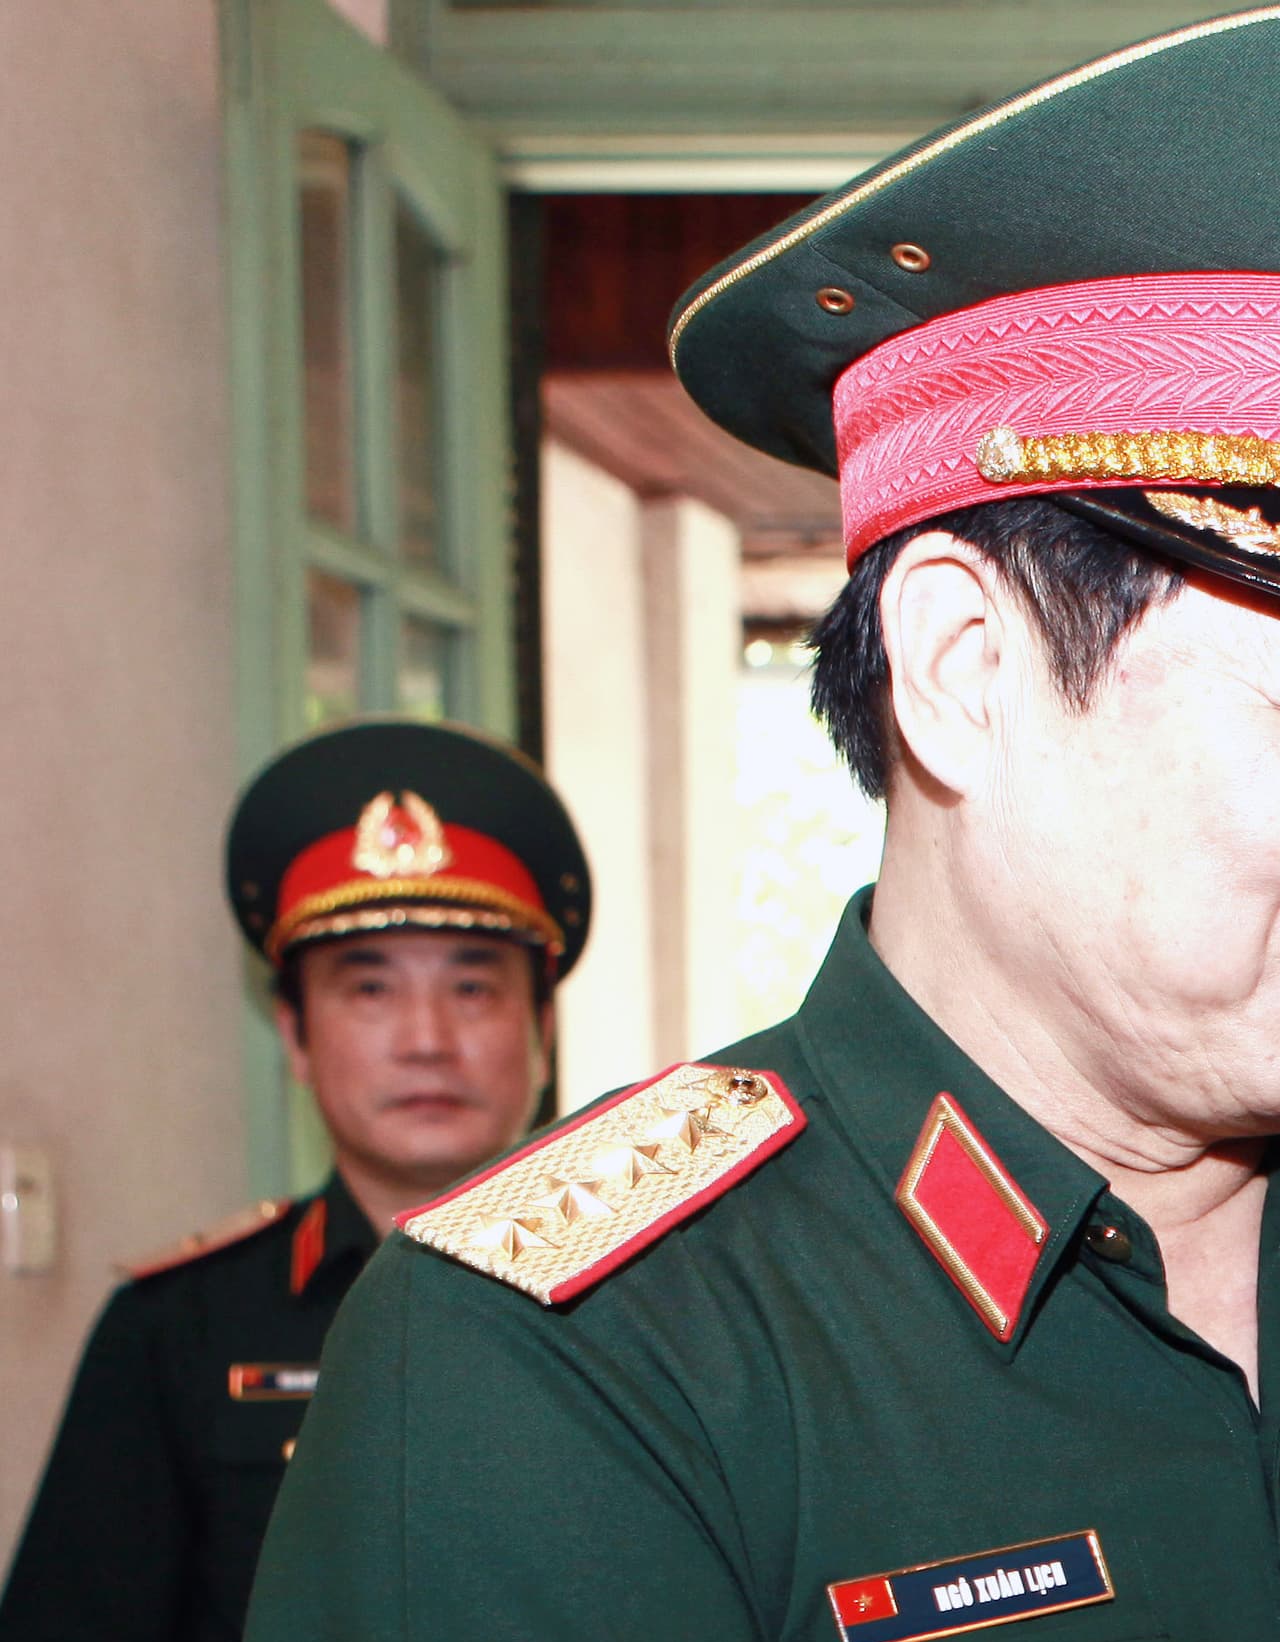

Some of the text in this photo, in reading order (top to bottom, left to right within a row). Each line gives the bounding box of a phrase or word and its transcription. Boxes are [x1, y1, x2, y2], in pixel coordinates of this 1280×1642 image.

[934, 1561, 1067, 1611] NGÔ XUÂN LỊCH
